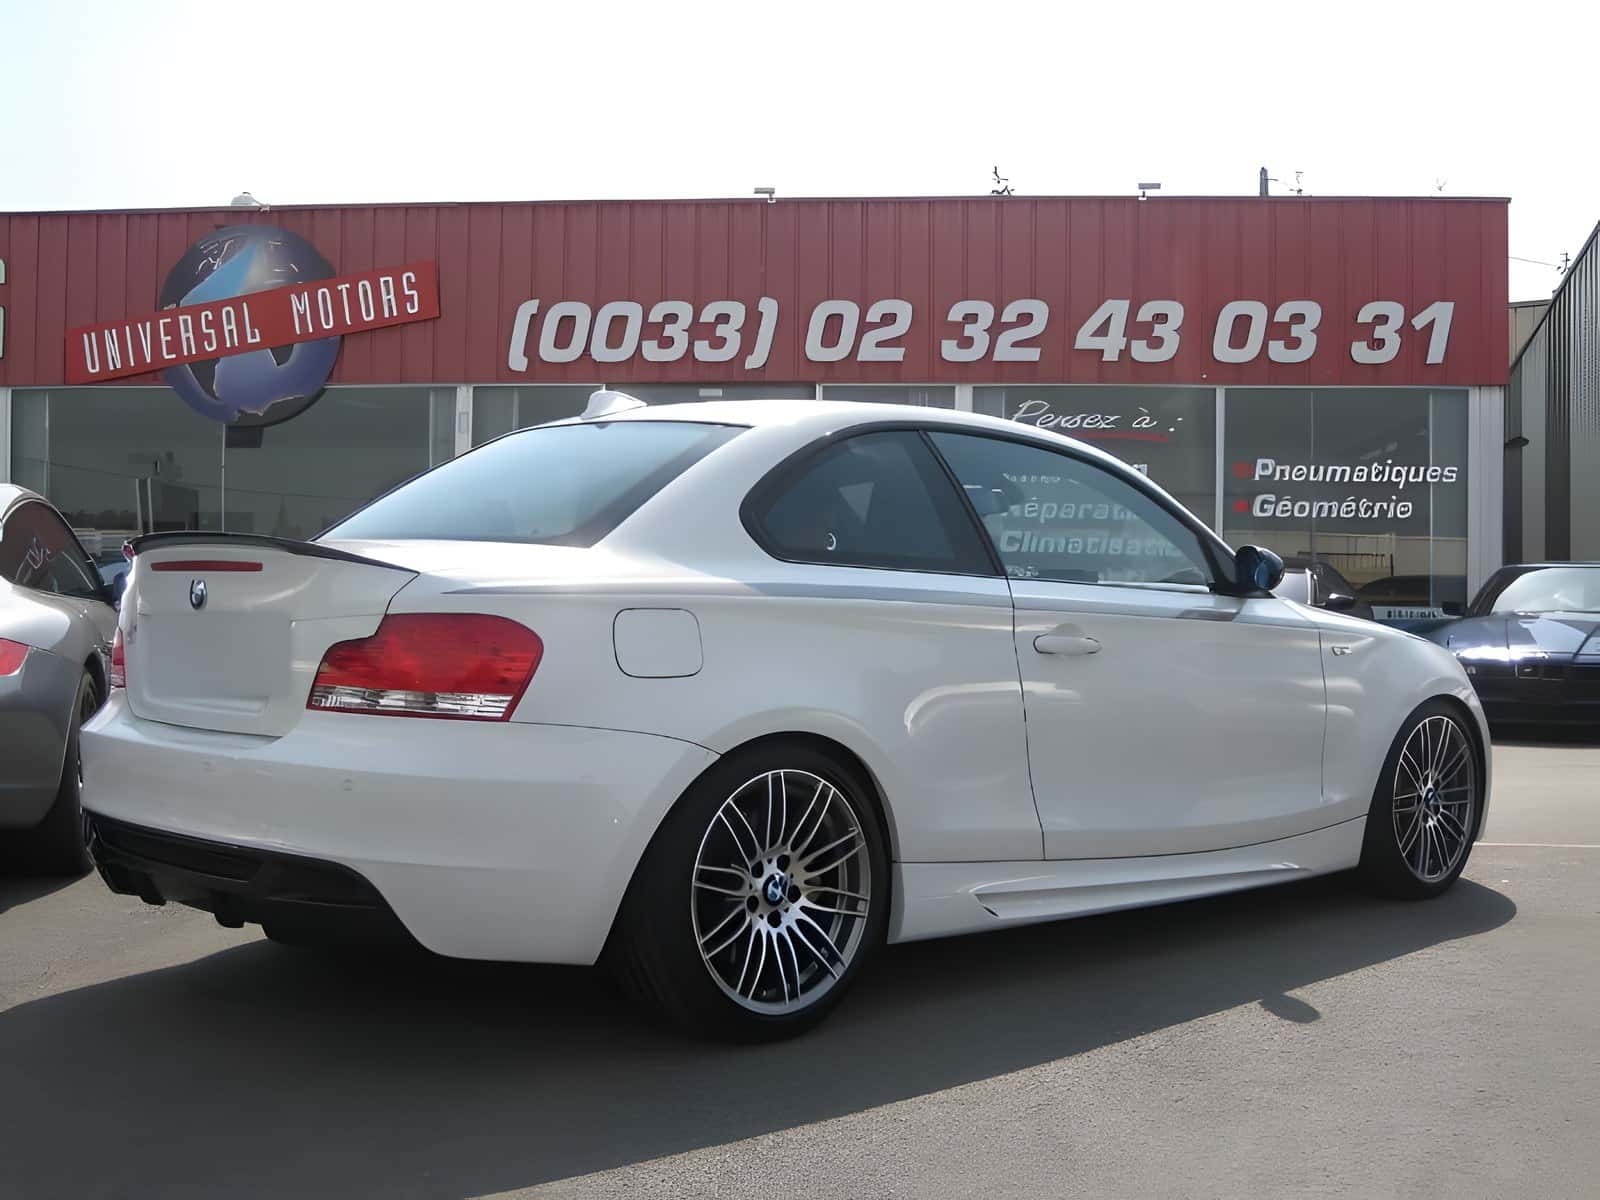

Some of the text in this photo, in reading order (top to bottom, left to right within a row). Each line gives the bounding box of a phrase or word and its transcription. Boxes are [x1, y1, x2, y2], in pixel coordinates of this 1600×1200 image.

[83, 301, 261, 374] UNIVERSAL
[290, 271, 420, 334] MOTORS
[507, 296, 1455, 372] (0033) 02 32 43 03 31
[1253, 457, 1459, 490] Pneumatiques
[1252, 493, 1413, 519] Géométrie
